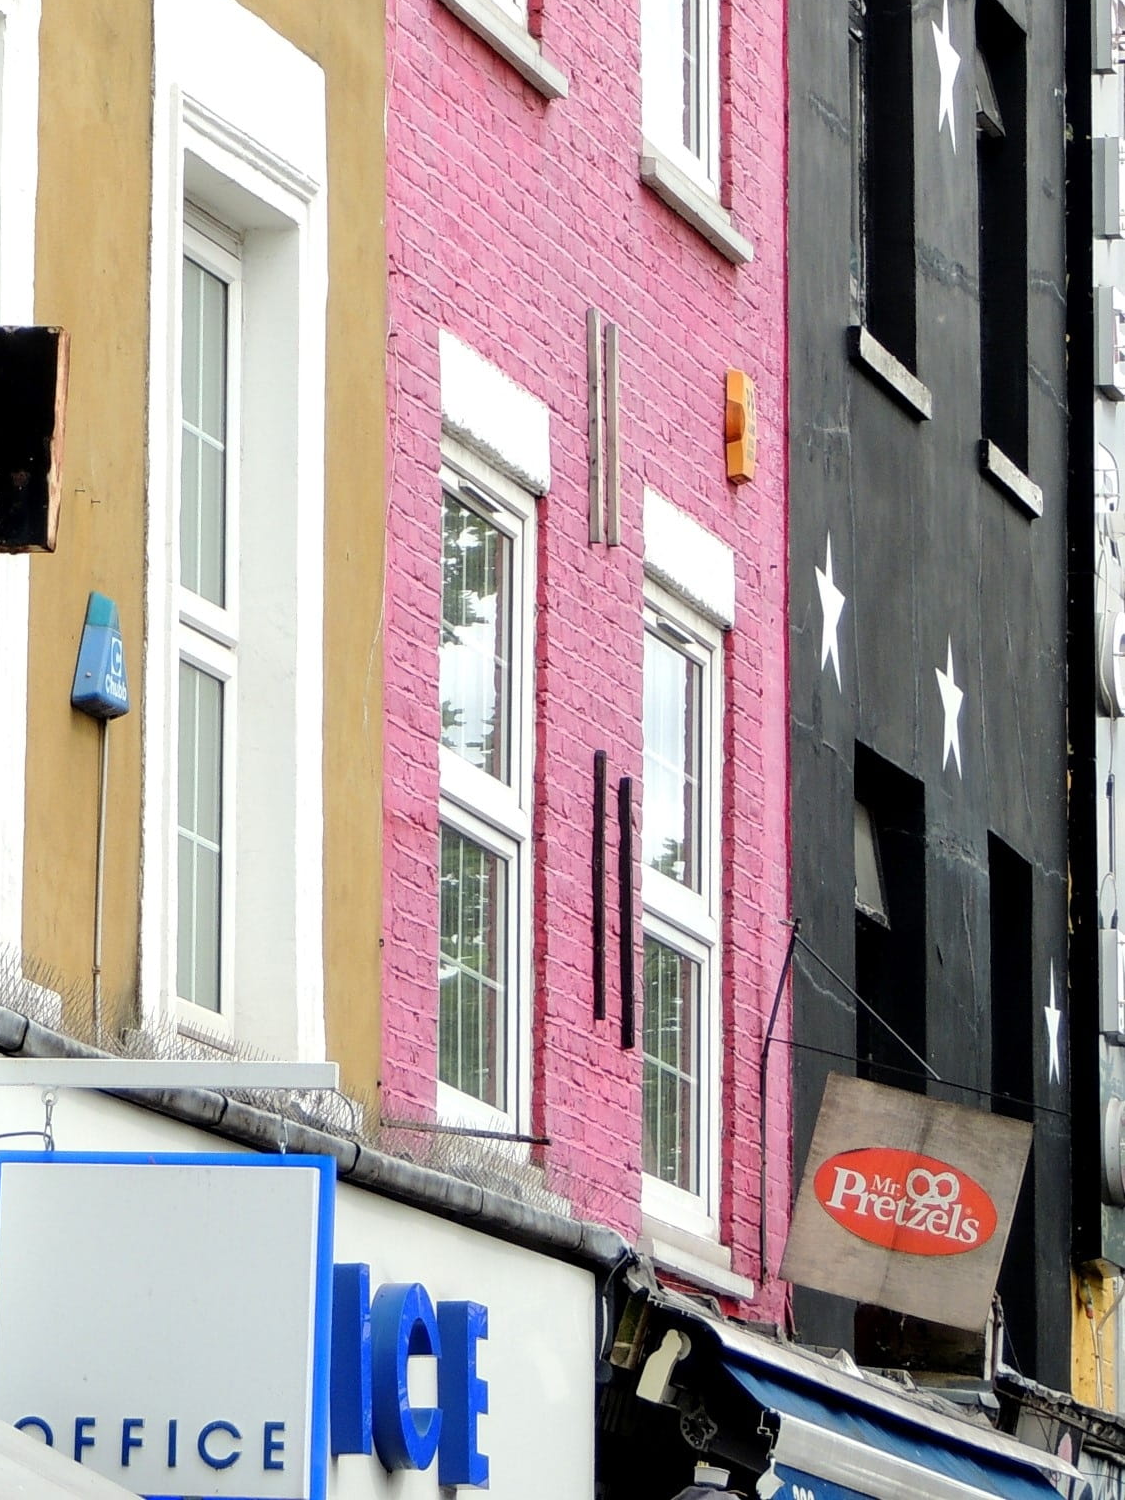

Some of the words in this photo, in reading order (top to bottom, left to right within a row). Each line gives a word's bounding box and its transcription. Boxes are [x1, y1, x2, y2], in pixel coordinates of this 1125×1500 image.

[105, 673, 127, 702] Chubb
[871, 1174, 901, 1197] Mr.
[826, 1166, 980, 1244] Pretzels
